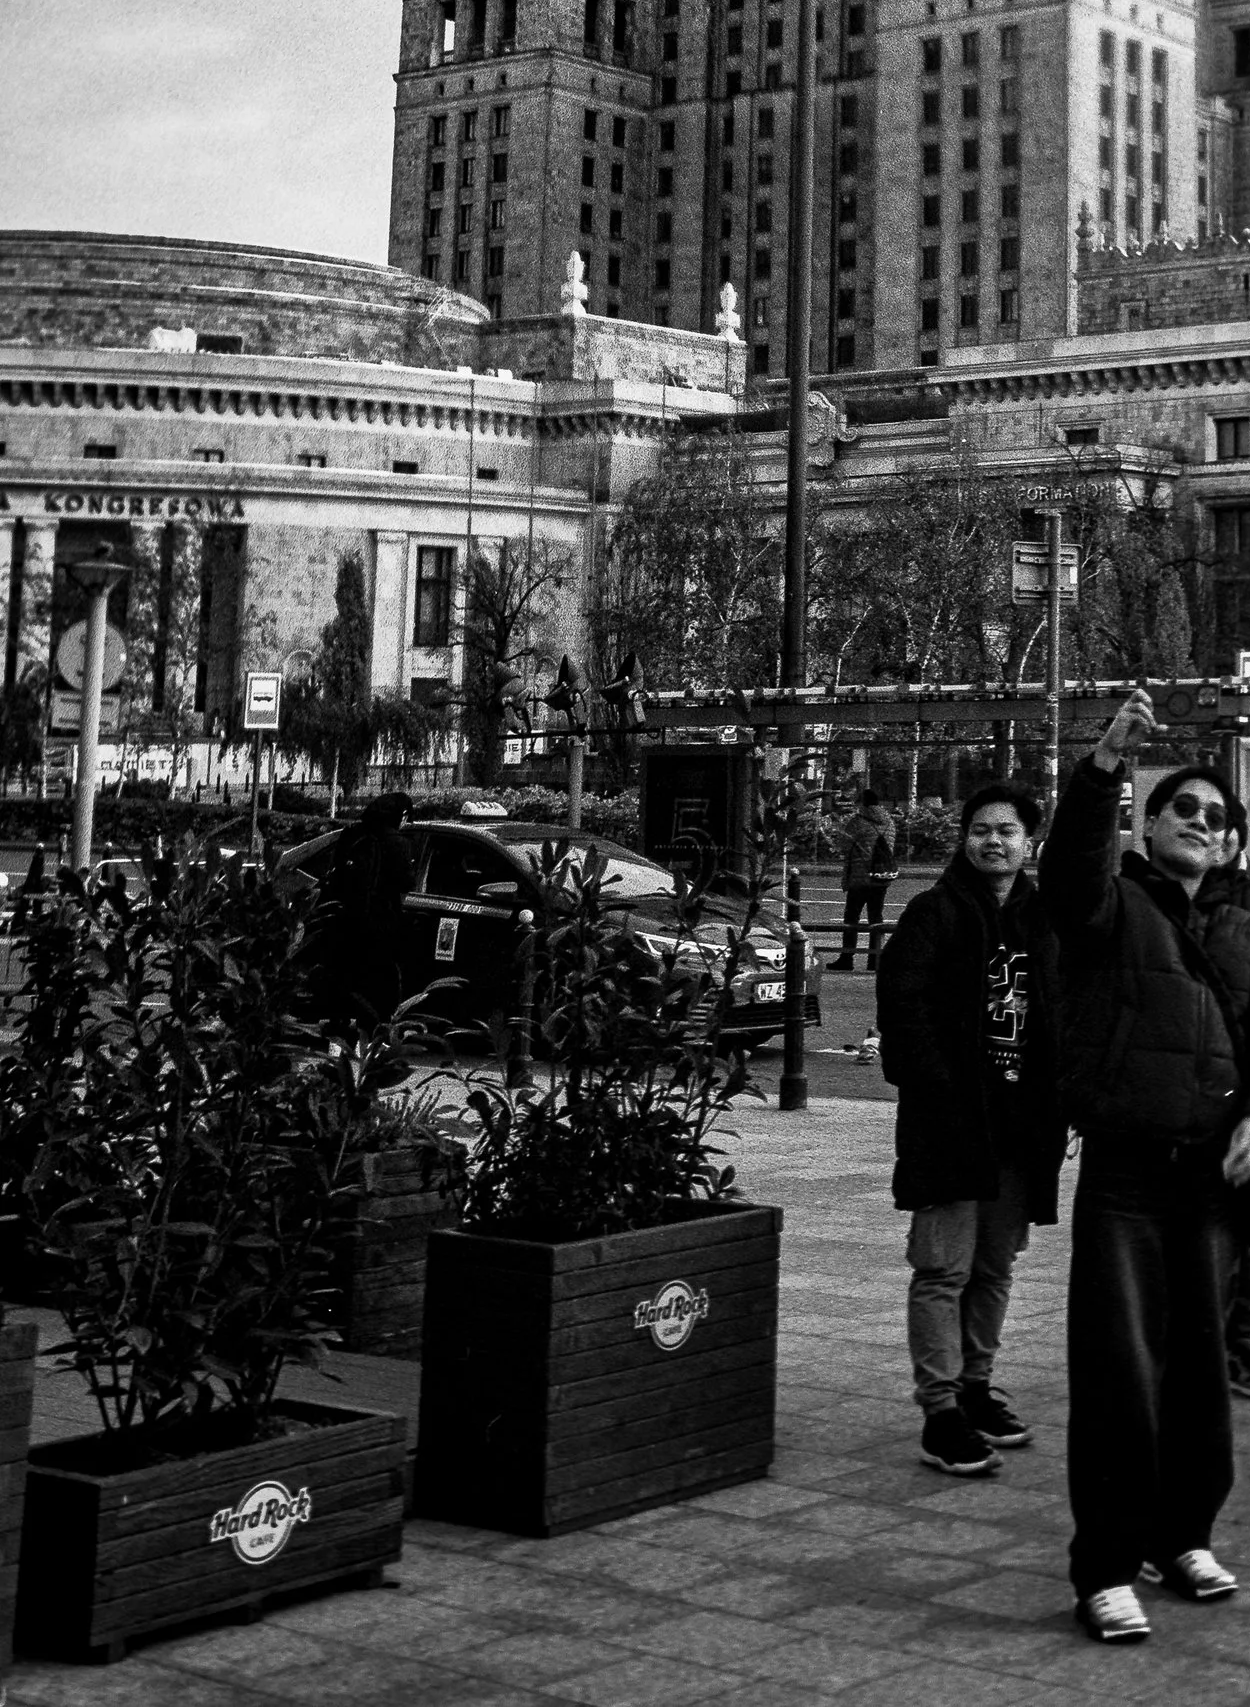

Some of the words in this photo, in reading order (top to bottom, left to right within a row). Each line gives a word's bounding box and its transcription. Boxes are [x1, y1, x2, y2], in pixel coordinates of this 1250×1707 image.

[43, 492, 246, 518] KONGRESOWA
[636, 1297, 675, 1326] Hard
[672, 1288, 708, 1322] Rock
[211, 1500, 264, 1540] Hard
[261, 1488, 310, 1529] Rock
